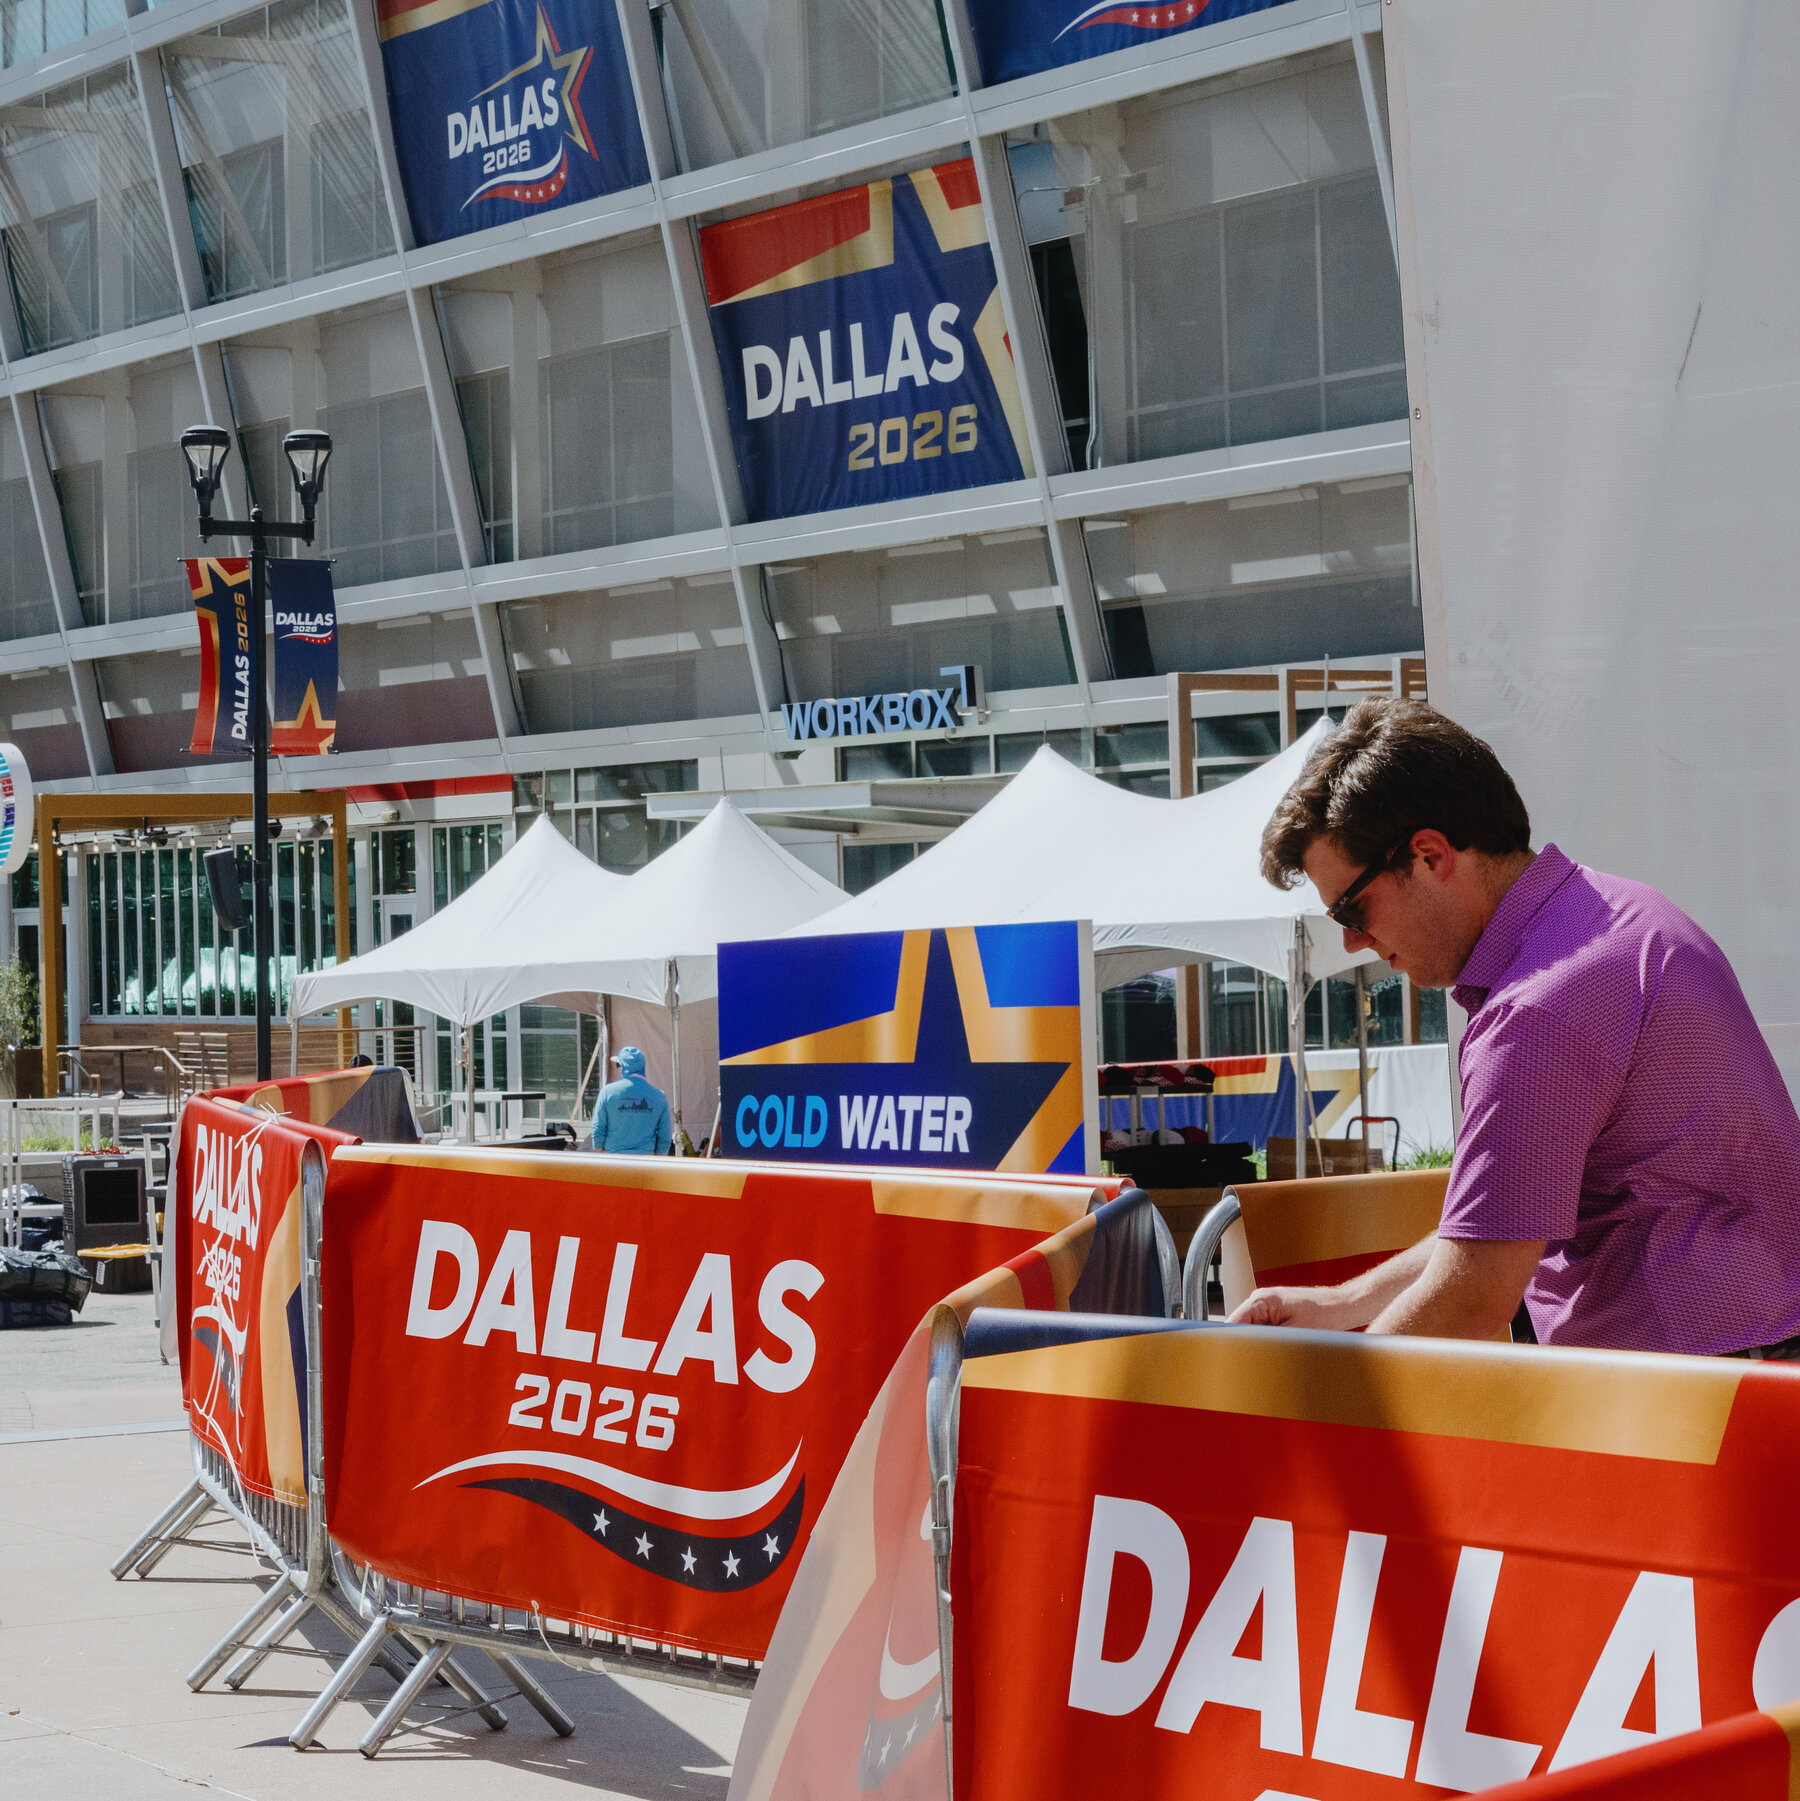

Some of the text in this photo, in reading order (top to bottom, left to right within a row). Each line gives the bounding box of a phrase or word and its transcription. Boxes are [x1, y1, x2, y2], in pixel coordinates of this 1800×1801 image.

[447, 78, 560, 160] DALLAS
[483, 139, 531, 174] 2026
[742, 302, 965, 420] DALLAS
[848, 404, 978, 472] 2026
[275, 612, 334, 626] DALLAS
[292, 625, 317, 633] 2026
[231, 591, 250, 741] DALLAS 2026
[781, 687, 956, 740] WORKBOX
[735, 1094, 973, 1153] COLD WATER
[192, 1123, 263, 1252] DALLAS
[405, 1219, 826, 1394] DALLAS
[507, 1373, 681, 1452] 2026
[1068, 1494, 1800, 1793] DALLA
